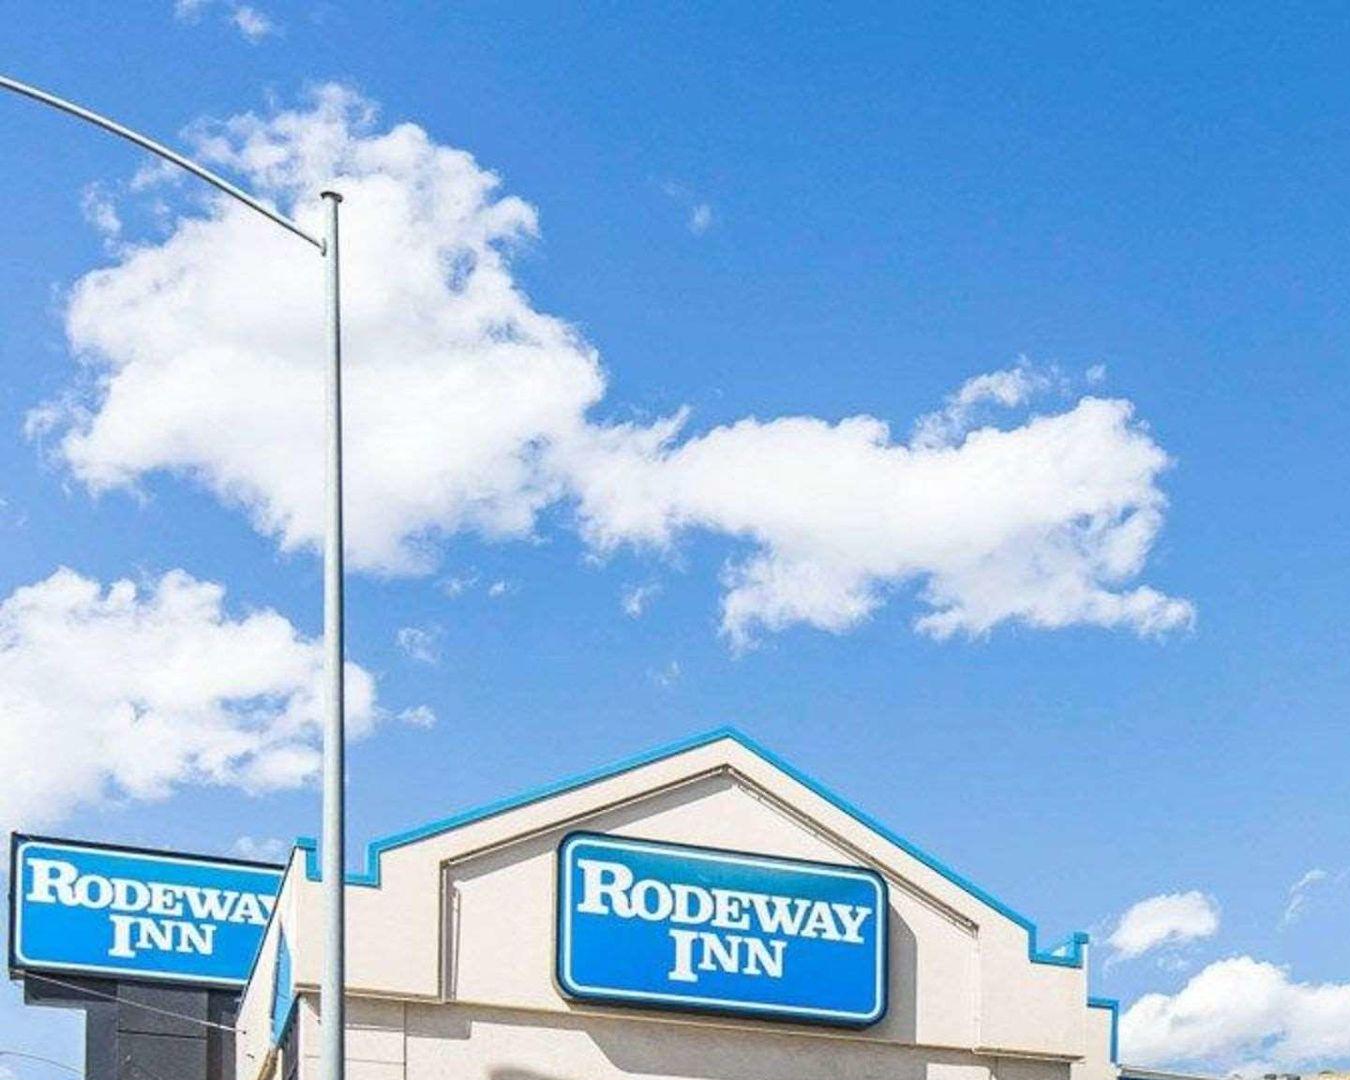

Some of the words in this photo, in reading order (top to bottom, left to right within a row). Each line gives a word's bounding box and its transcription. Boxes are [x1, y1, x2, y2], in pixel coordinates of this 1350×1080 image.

[577, 859, 872, 944] RODEWAY
[108, 914, 217, 959] INN
[668, 928, 787, 983] INN
